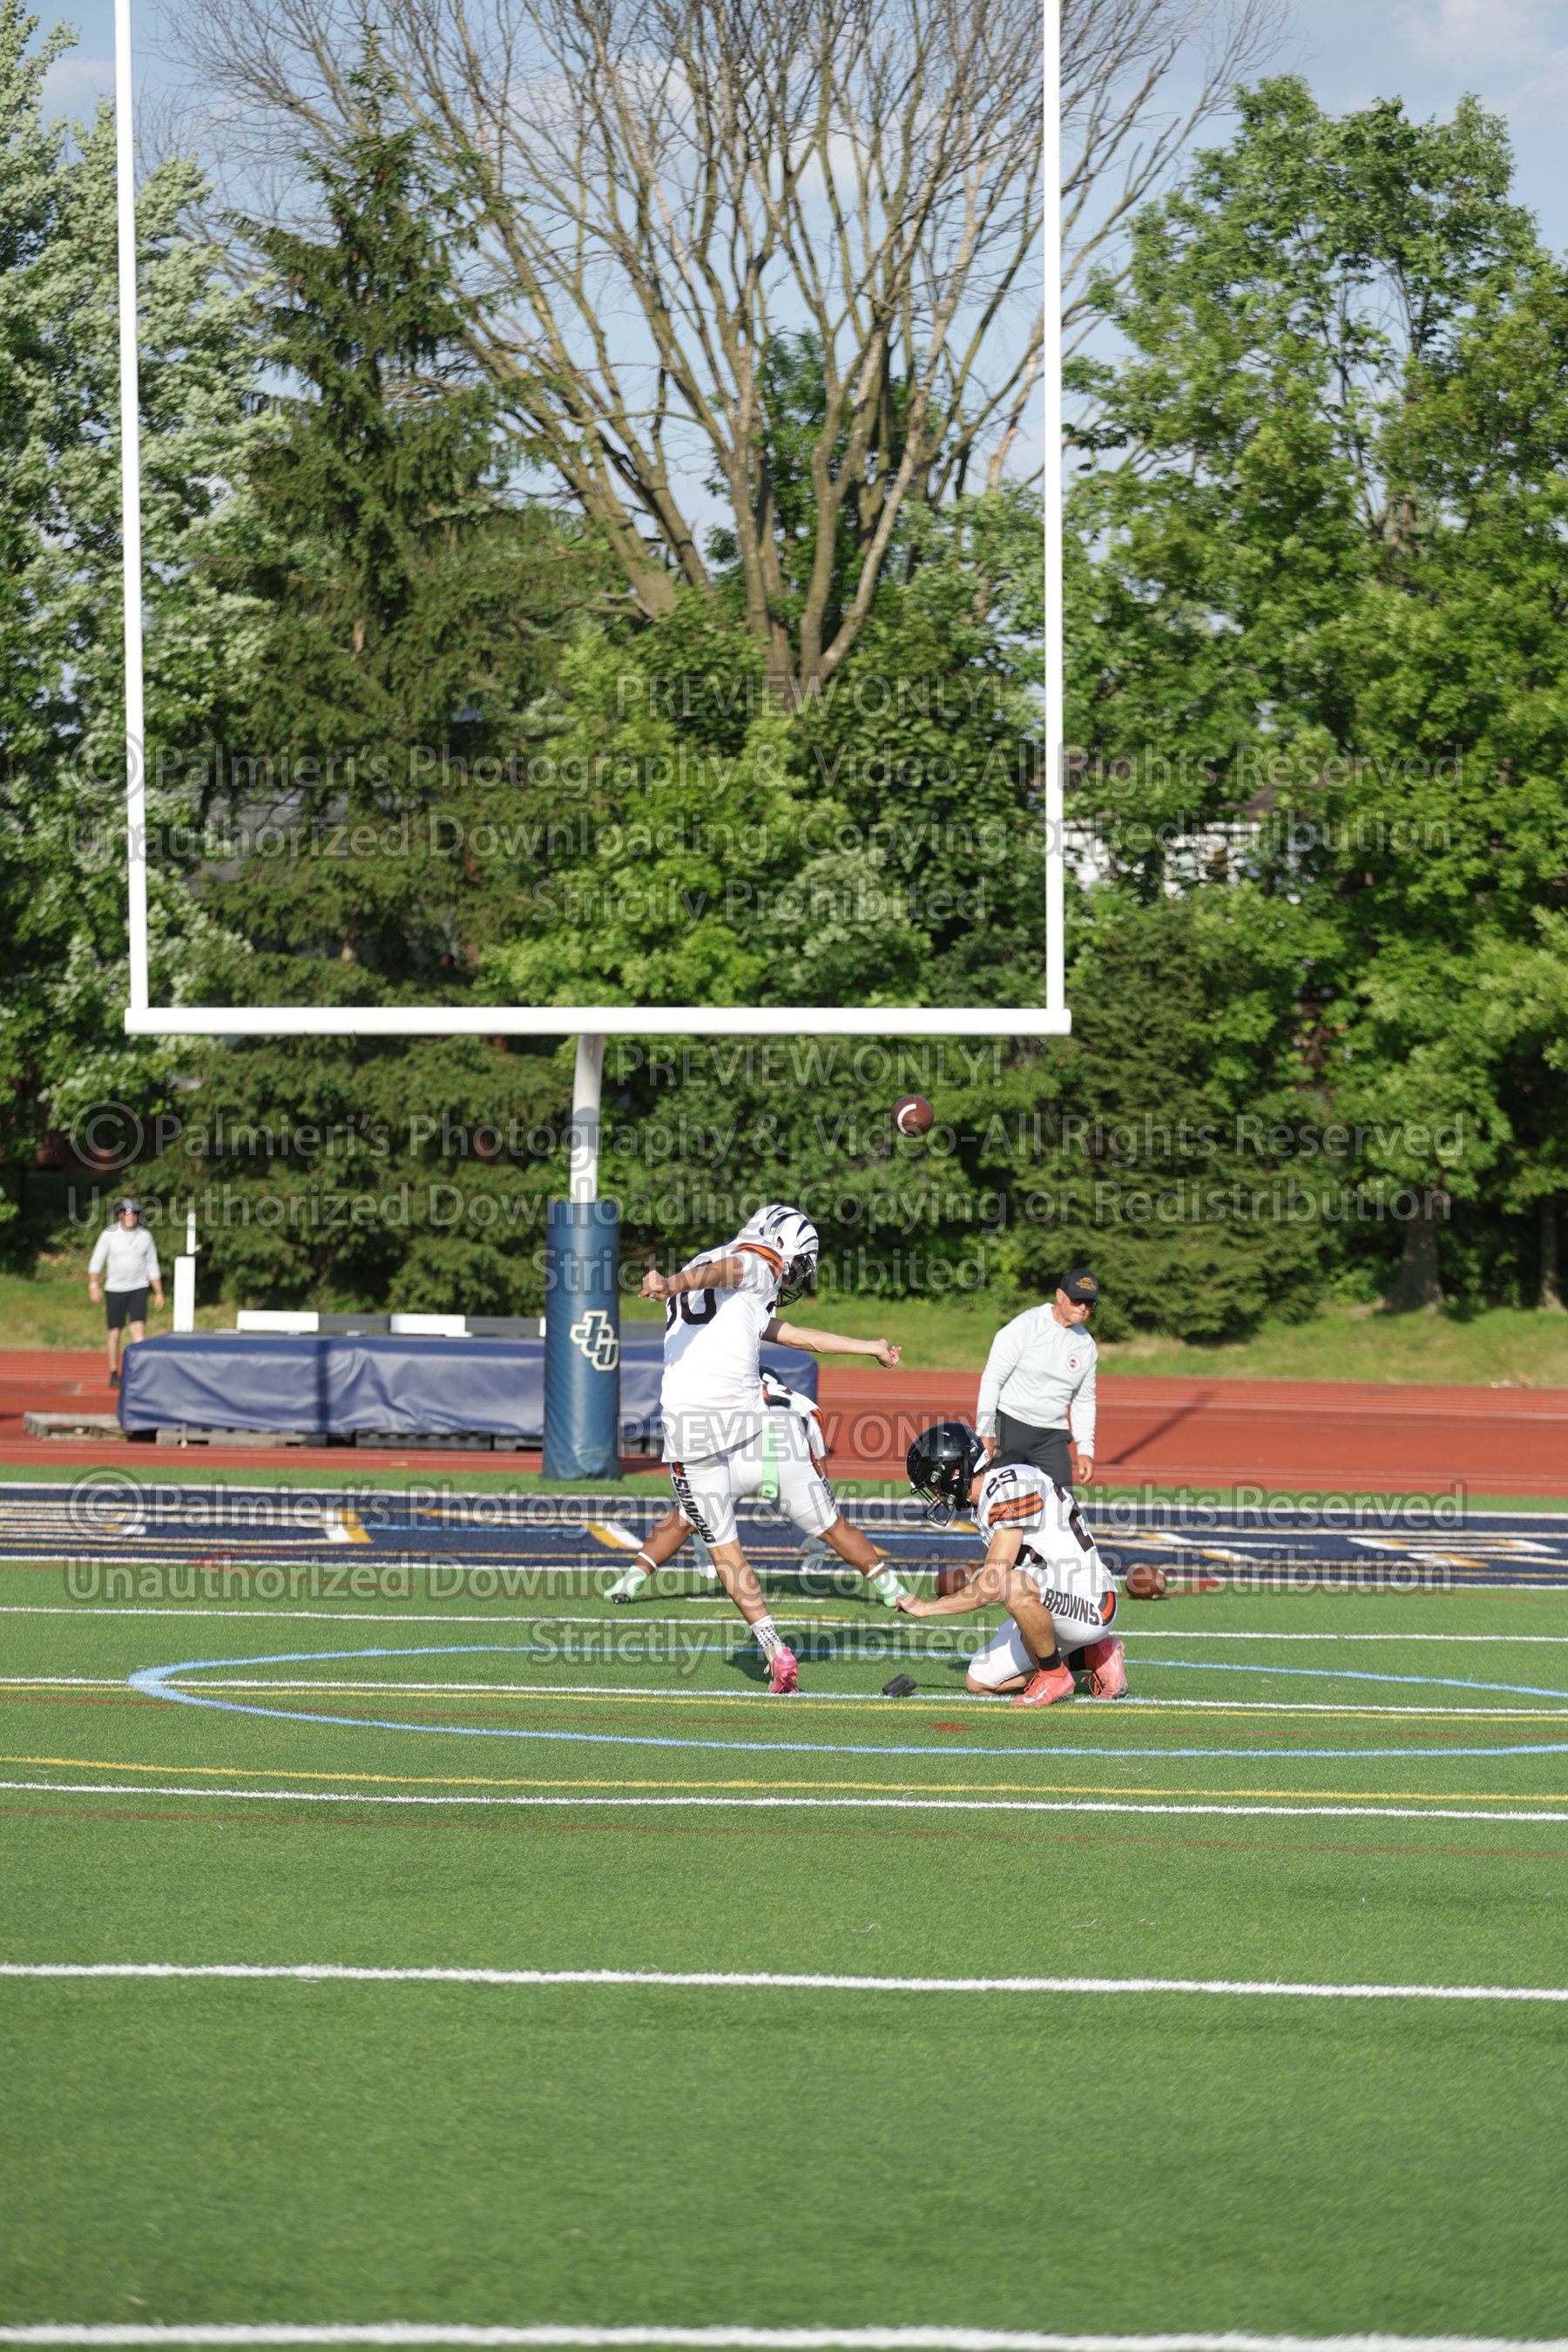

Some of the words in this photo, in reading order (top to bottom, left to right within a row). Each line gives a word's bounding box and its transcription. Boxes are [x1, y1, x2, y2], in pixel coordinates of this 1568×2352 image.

[570, 1310, 619, 1371] JCU
[986, 1469, 1017, 1498] 29
[1043, 1587, 1099, 1626] BROWNS
